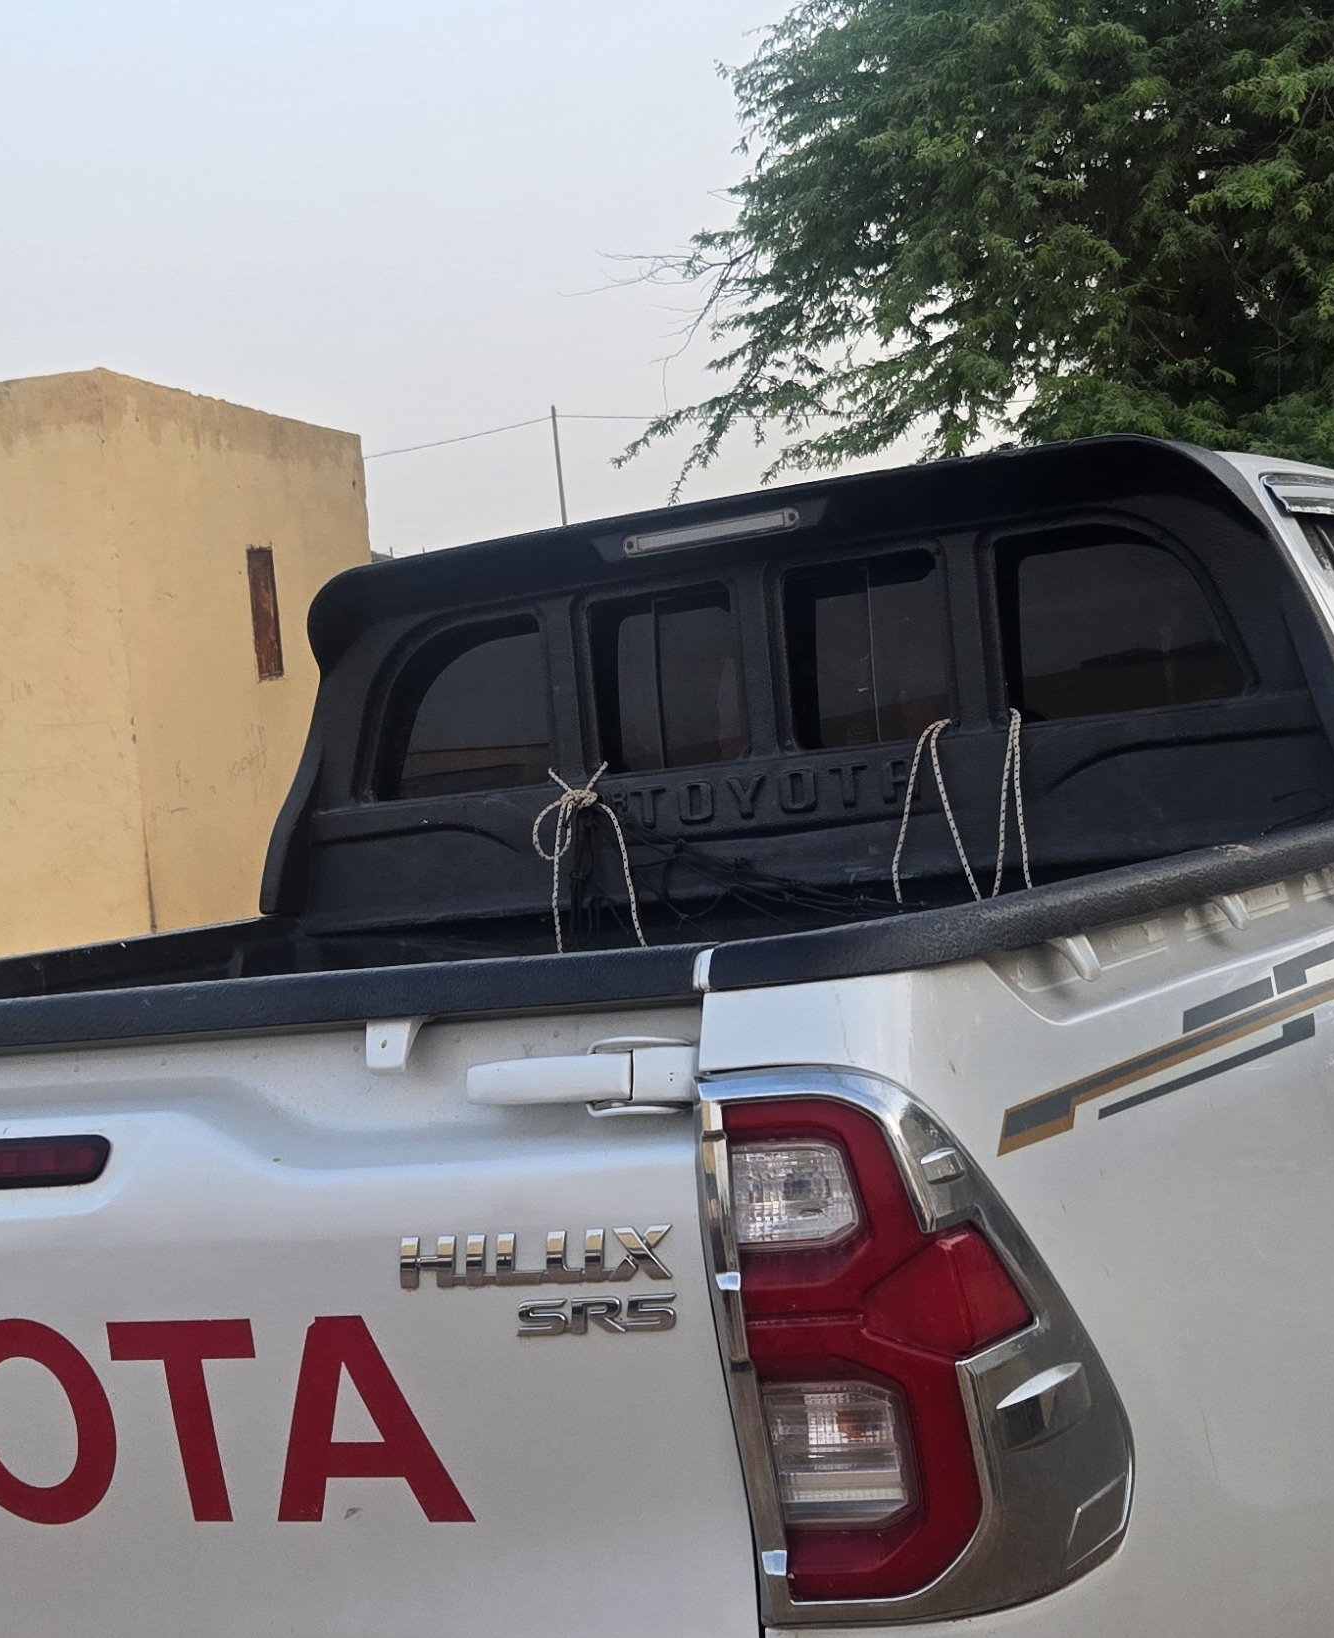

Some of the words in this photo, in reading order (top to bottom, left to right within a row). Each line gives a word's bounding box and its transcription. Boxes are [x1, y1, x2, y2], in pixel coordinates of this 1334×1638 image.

[629, 757, 922, 830] TOYOTA
[399, 1222, 674, 1291] HILUX
[516, 1292, 678, 1338] SR5
